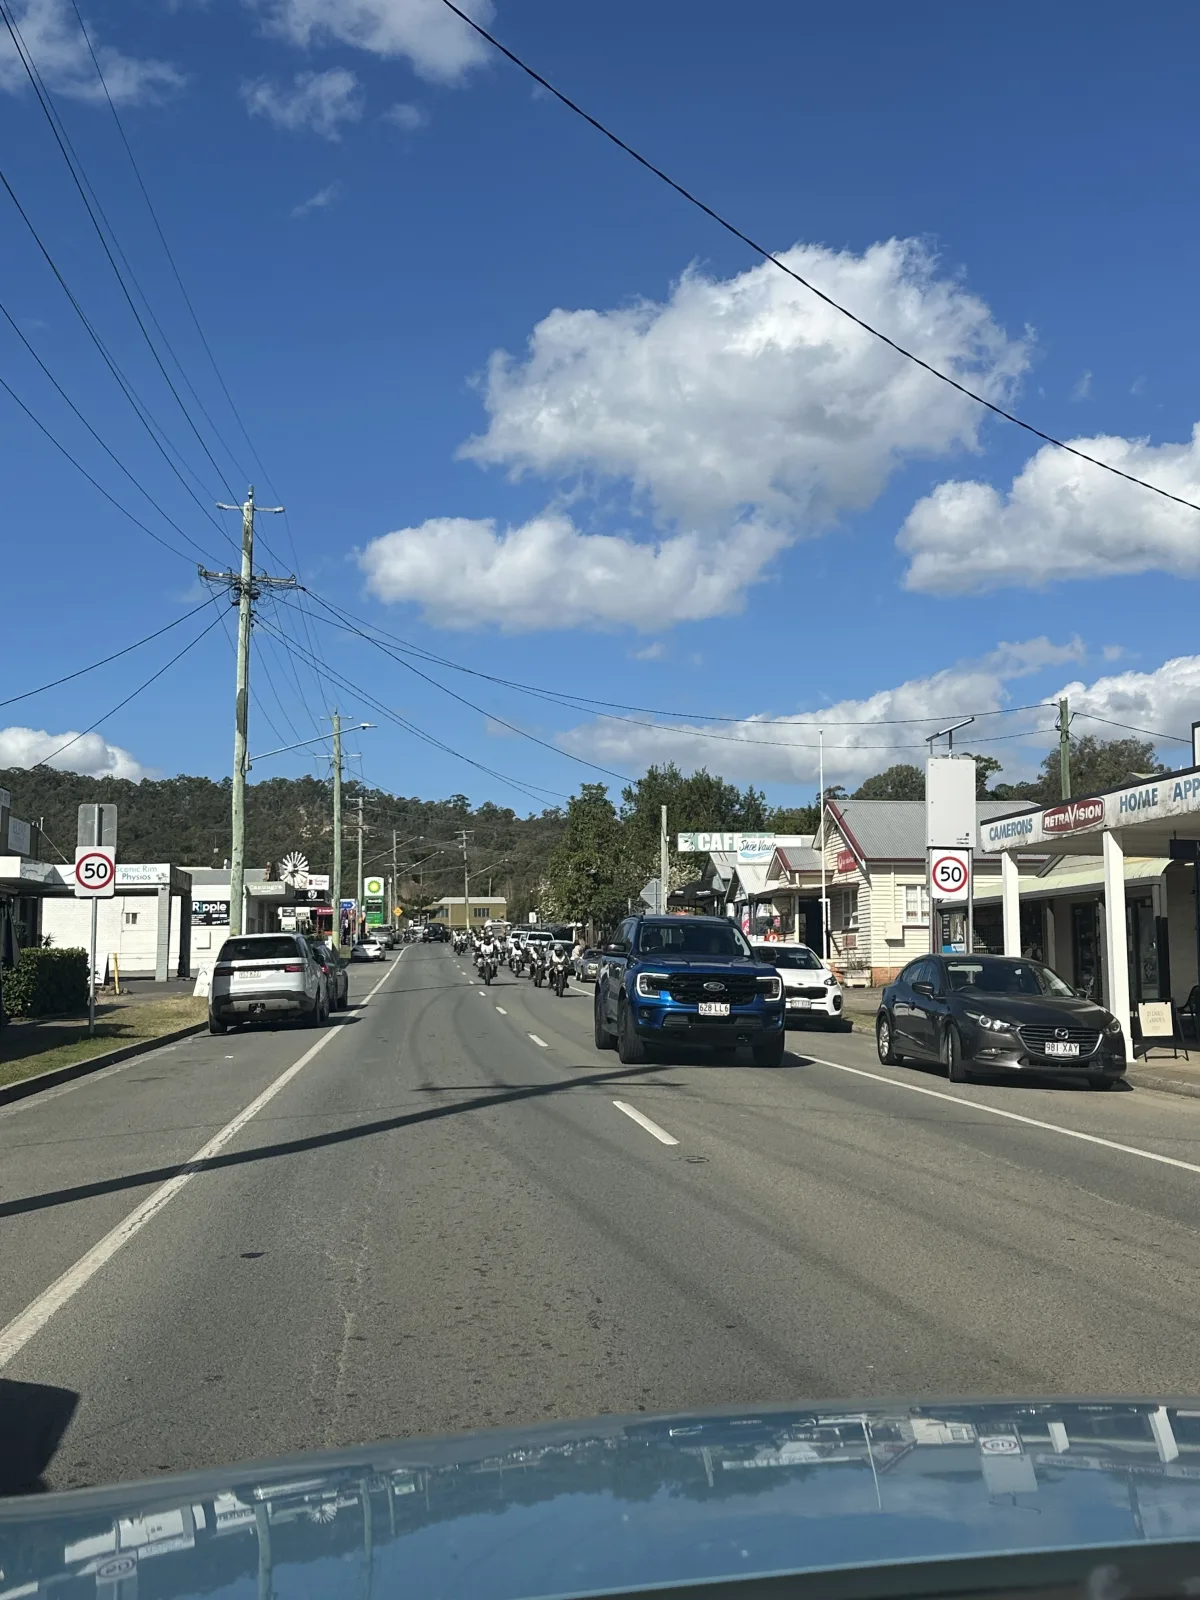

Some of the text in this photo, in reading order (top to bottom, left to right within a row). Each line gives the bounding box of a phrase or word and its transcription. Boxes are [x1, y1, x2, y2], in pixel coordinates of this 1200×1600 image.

[989, 818, 1033, 841] CAMERONS
[1119, 787, 1158, 813] HOME
[738, 840, 757, 852] Shoe
[84, 862, 108, 879] 50
[940, 866, 962, 882] 50
[121, 873, 151, 881] Physios
[192, 902, 227, 913] Ripple
[699, 1004, 712, 1012] 628
[1046, 1042, 1079, 1052] 981 XAY
